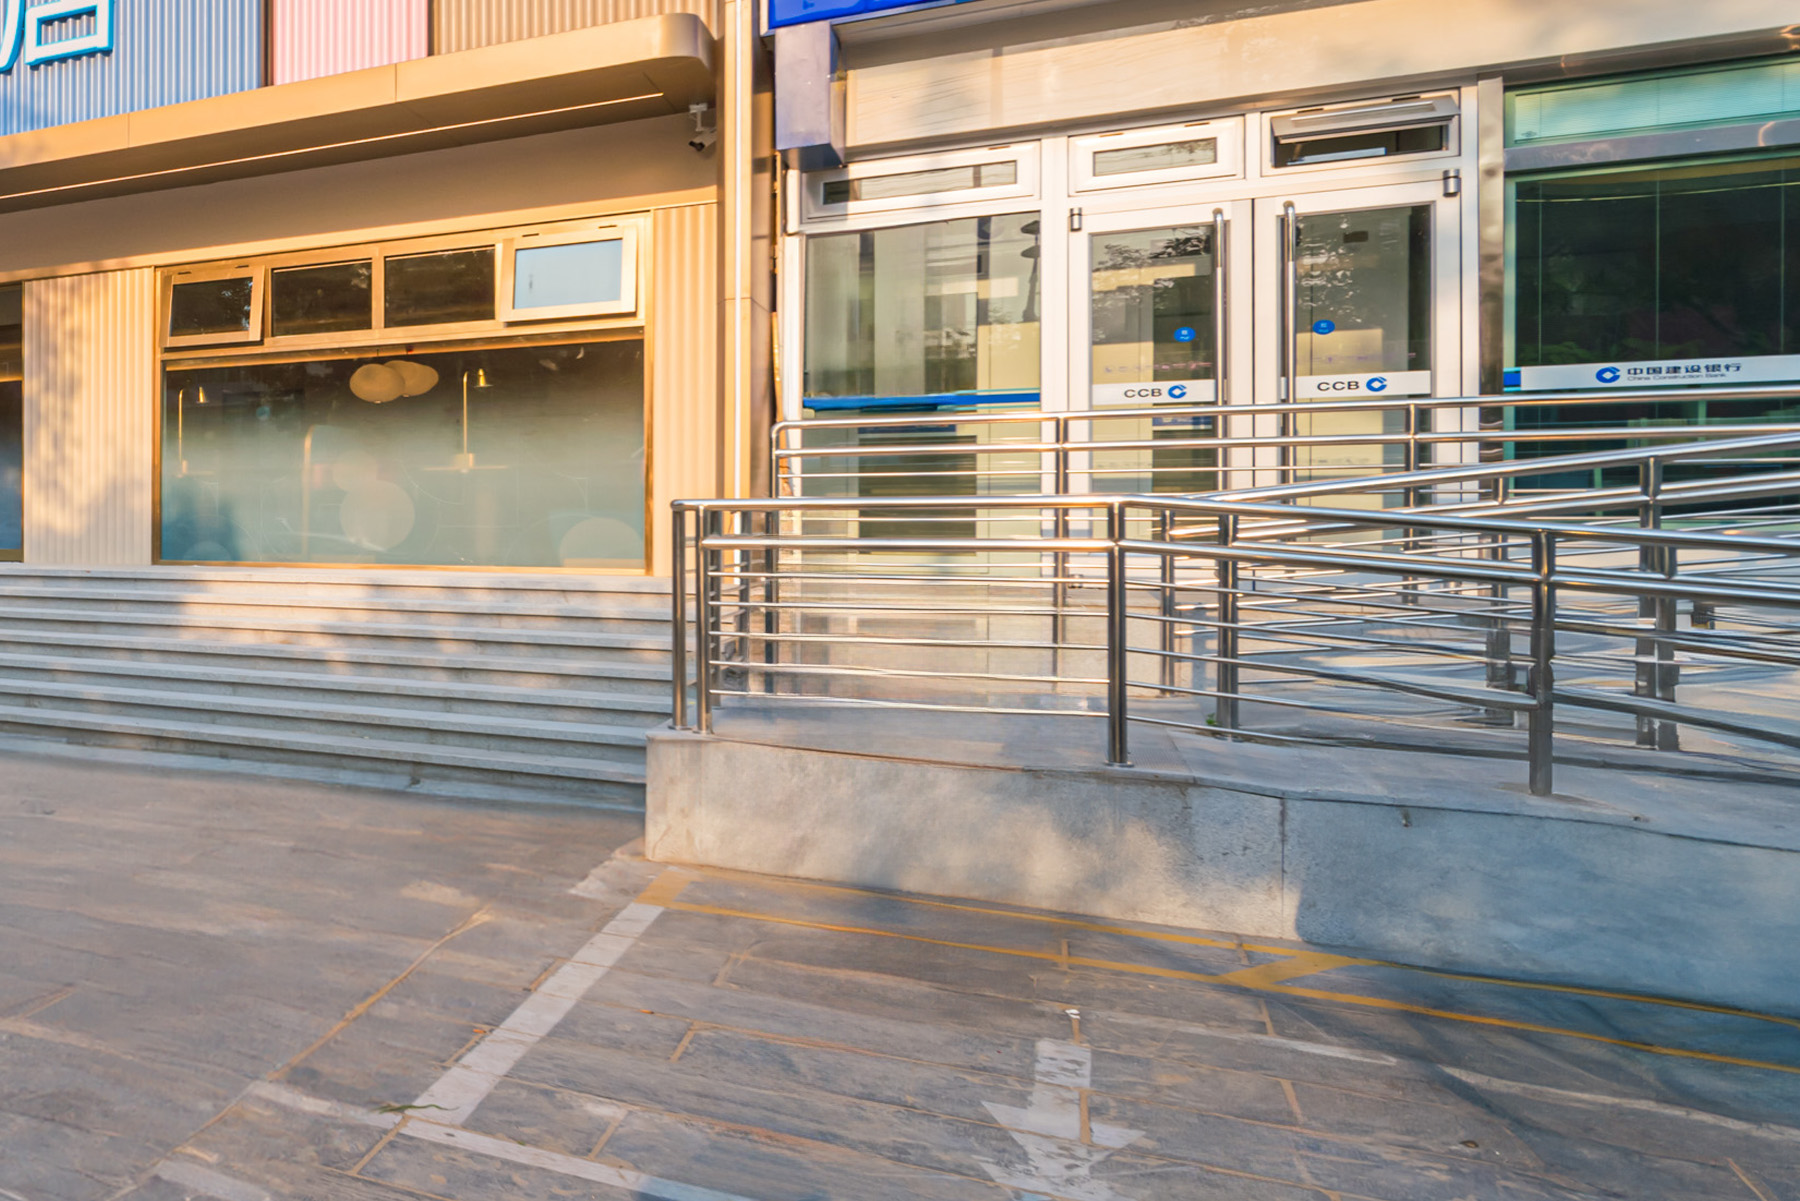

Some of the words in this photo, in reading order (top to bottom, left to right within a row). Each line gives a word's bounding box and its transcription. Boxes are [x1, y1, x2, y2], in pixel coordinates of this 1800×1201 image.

[1627, 363, 1741, 375] 中国建设银行
[1317, 381, 1360, 391] CCB
[1124, 388, 1162, 398] CCB
